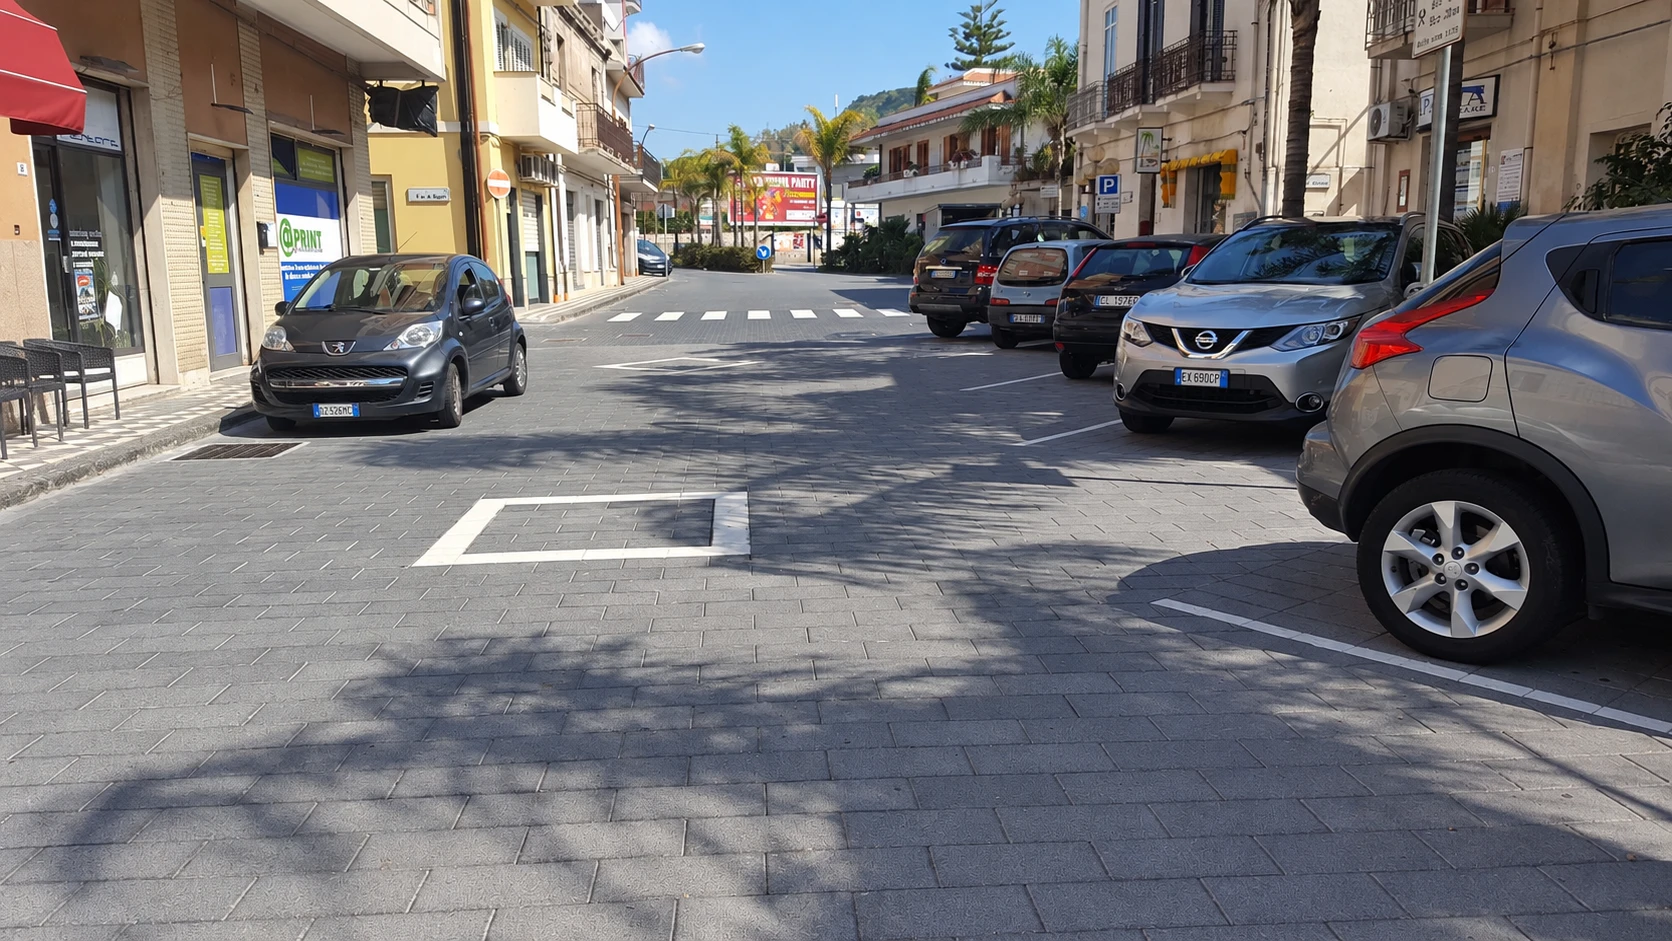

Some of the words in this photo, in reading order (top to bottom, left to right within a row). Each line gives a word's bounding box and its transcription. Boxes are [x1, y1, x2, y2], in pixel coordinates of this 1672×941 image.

[1103, 178, 1115, 193] P
[1100, 296, 1110, 305] CL
[1182, 371, 1192, 383] EX
